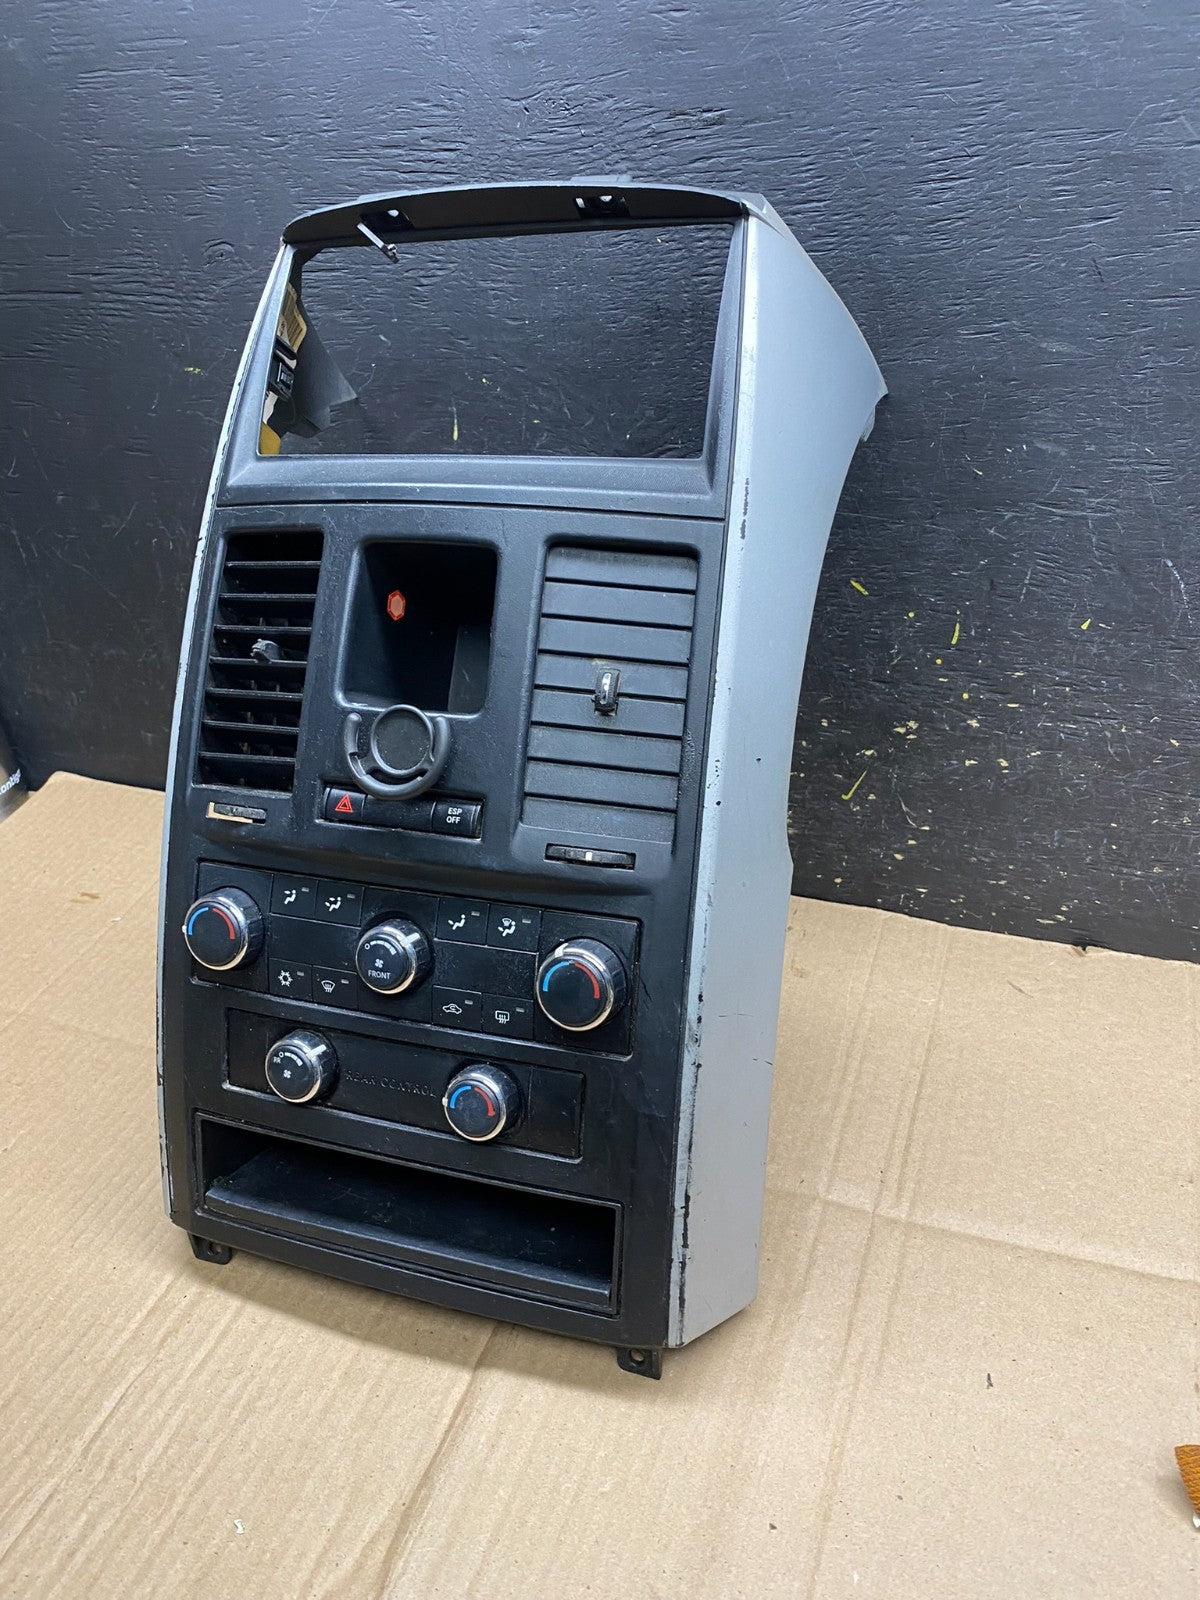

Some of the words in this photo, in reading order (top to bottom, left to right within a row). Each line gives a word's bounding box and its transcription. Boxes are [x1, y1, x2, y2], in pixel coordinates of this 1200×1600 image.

[447, 807, 463, 815] ESP
[446, 815, 461, 824] OFF
[367, 969, 391, 980] FRONT
[344, 1069, 376, 1086] REAR
[380, 1075, 438, 1099] CONTROL
